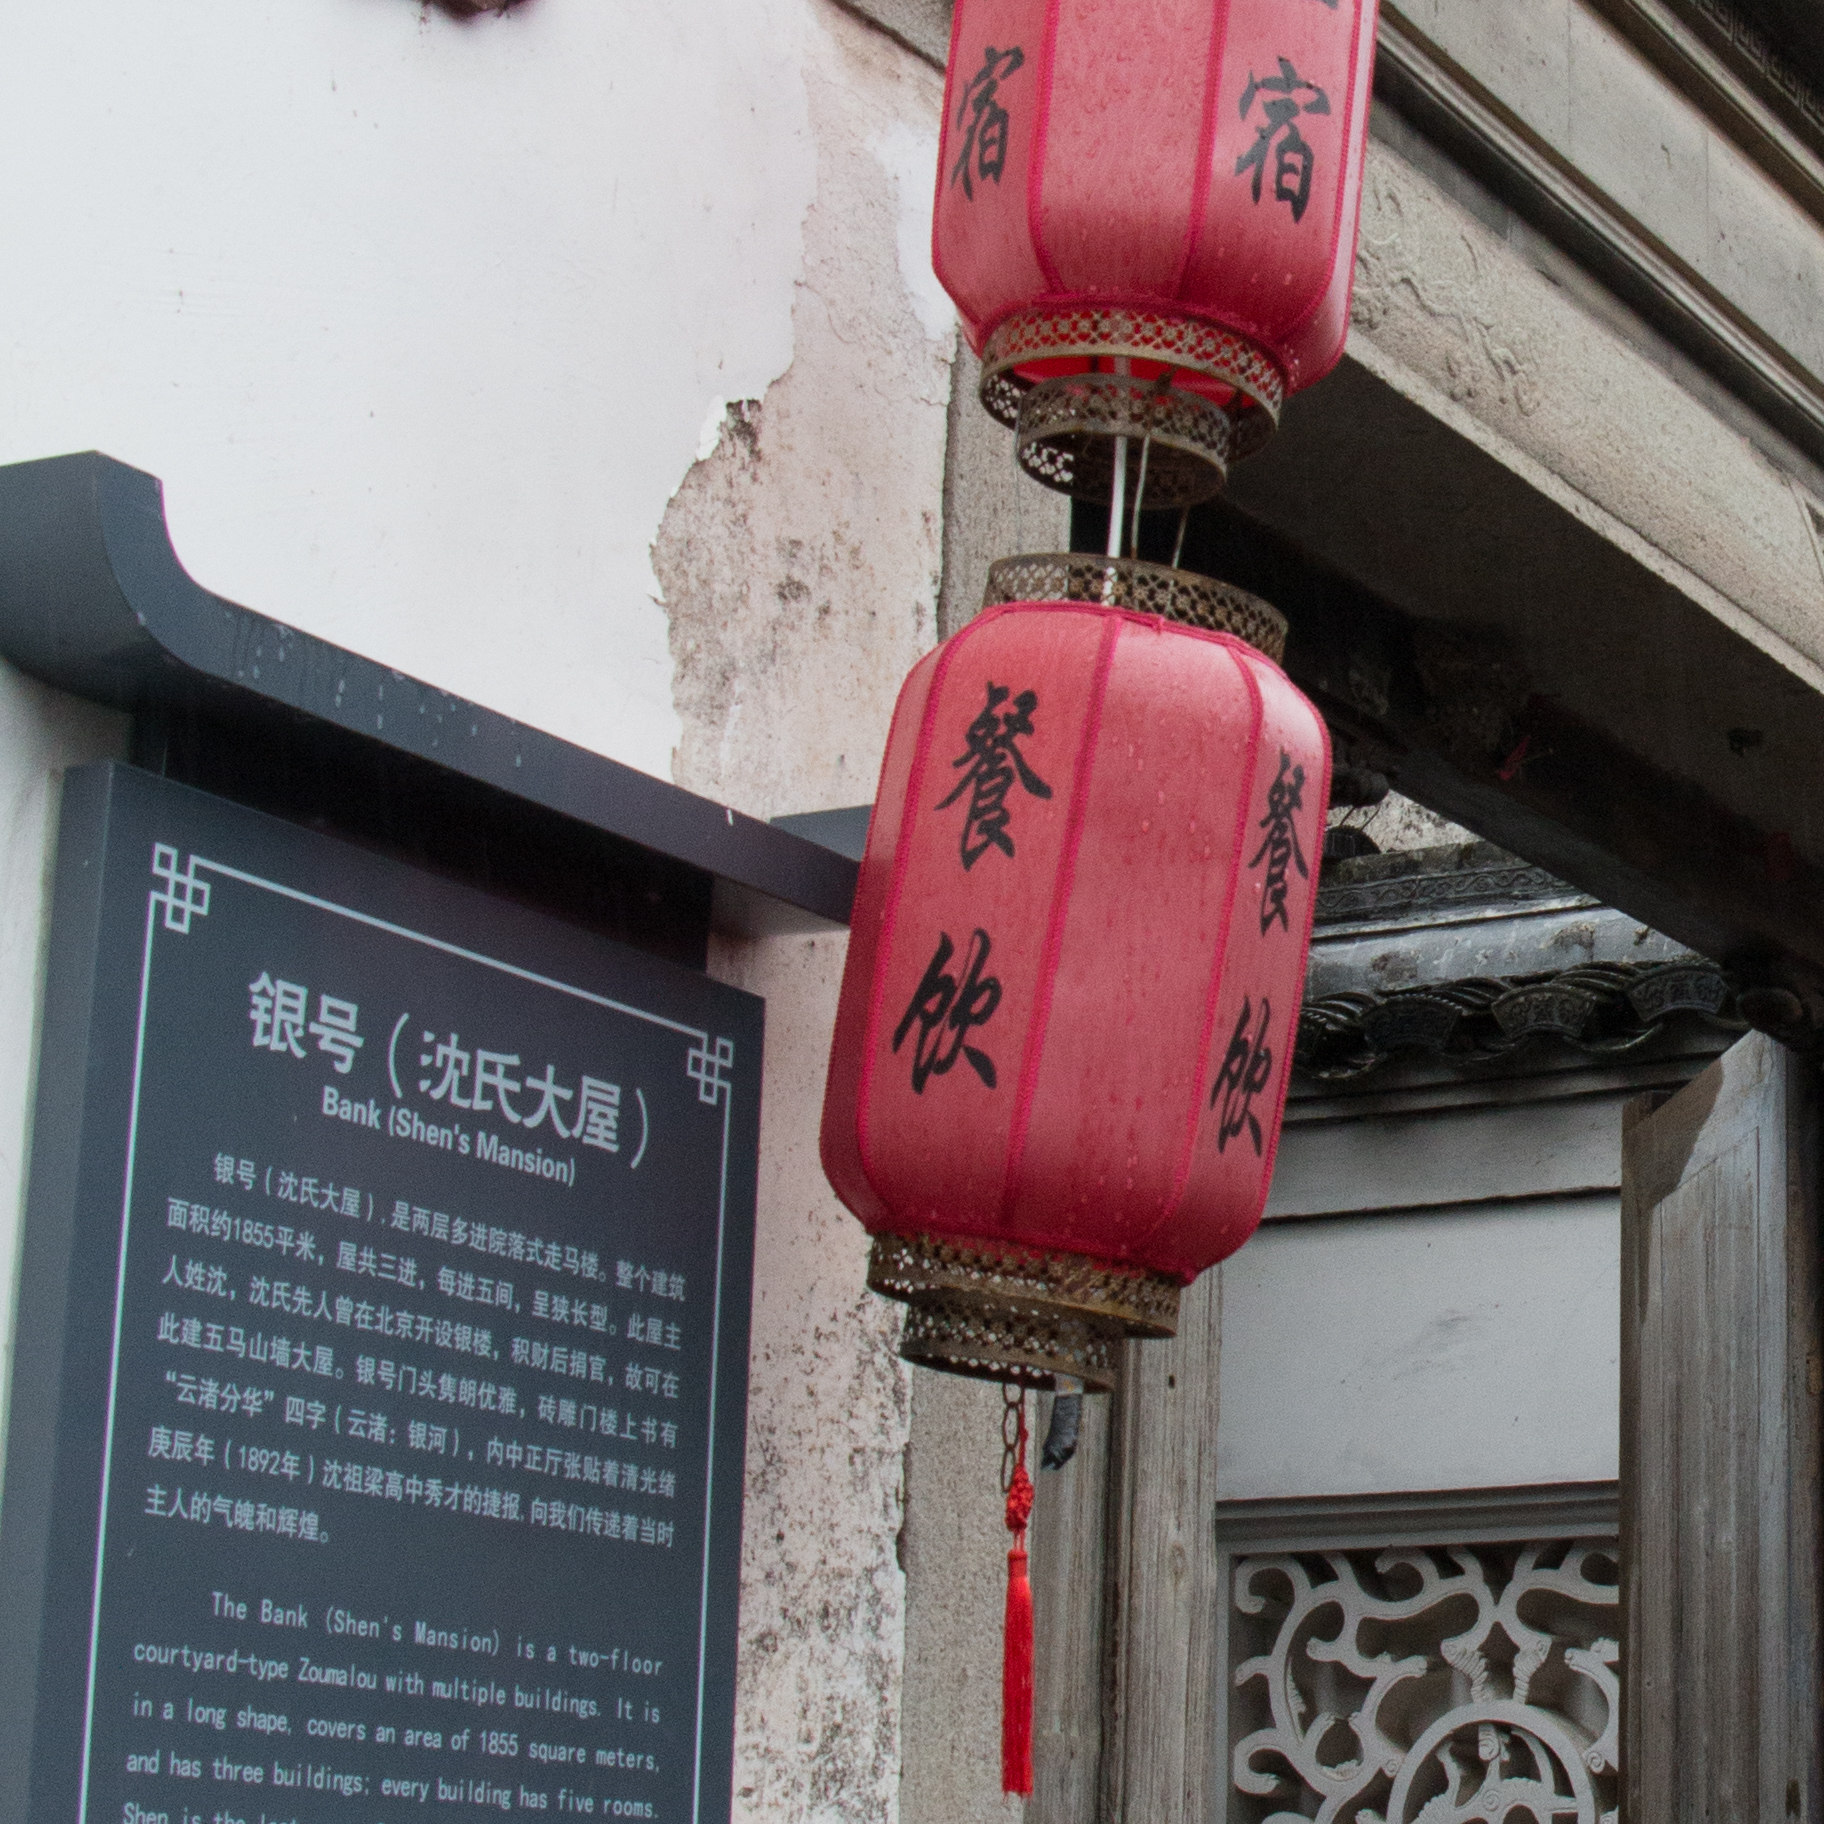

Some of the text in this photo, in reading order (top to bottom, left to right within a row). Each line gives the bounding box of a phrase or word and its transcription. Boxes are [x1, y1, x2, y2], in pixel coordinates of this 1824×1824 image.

[892, 680, 1054, 1096] 餐饮
[1209, 752, 1309, 1158] 餐饮
[321, 1084, 576, 1188] Bank (Shen's Mansion)
[212, 1590, 663, 1676] The Bank (Shen's Mansion) is a two-floor
[133, 1643, 633, 1721] courtyard-type Zoumalou with multiple buildings. It
[133, 1691, 660, 1773] in long shape, covers an area of 1855 square meters,
[126, 1748, 658, 1819] and has three buildings; every building has five rooms.
